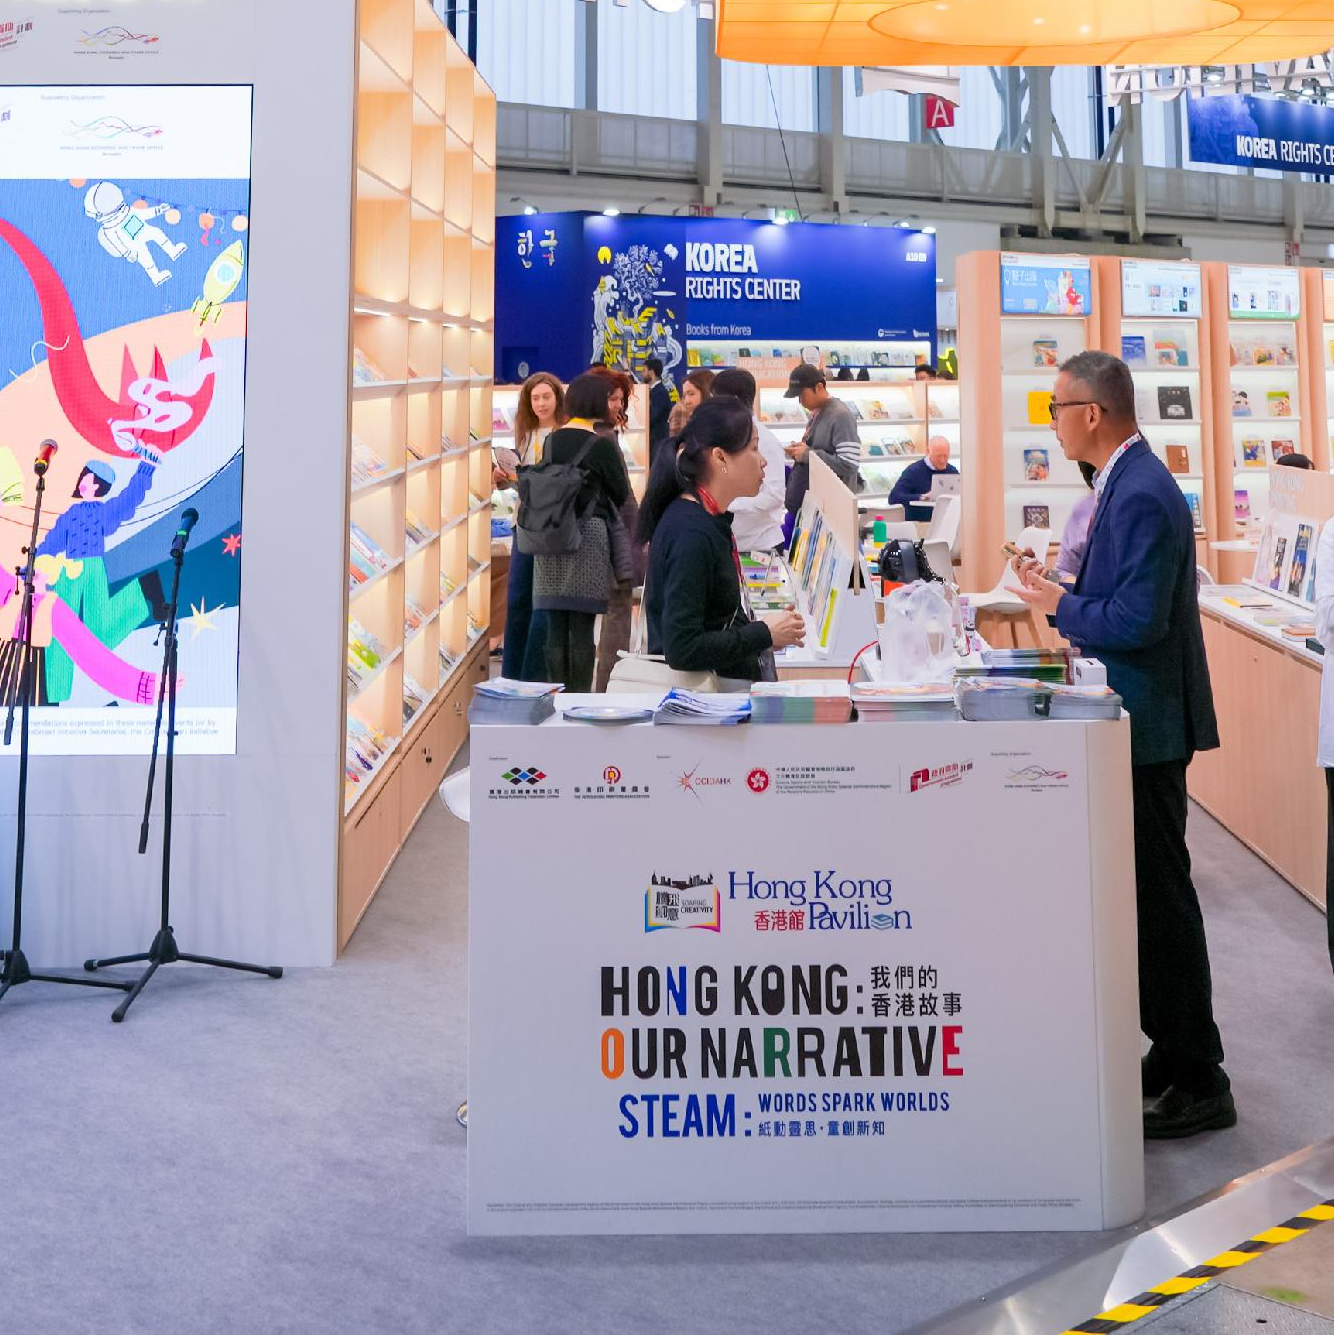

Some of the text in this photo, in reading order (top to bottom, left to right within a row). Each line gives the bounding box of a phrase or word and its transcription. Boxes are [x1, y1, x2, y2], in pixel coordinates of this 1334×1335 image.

[931, 100, 950, 127] A
[1236, 134, 1277, 160] KOREA
[1280, 143, 1321, 164] RIGHTS
[685, 242, 758, 274] KOREA
[685, 277, 801, 301] RIGHTS CENTER
[685, 323, 752, 337] Books from Korea
[695, 777, 732, 785] CCIDAHK
[728, 870, 893, 906] Hong Kong
[754, 909, 805, 931] 香港館
[870, 965, 938, 990] 我們的
[601, 965, 718, 1016] HONG
[870, 992, 963, 1017] 香港故事
[601, 1025, 964, 1079] OUR NARRATIVE
[758, 1093, 817, 1113] WORDS
[822, 1092, 876, 1112] SPARK
[880, 1091, 950, 1112] WORLDS
